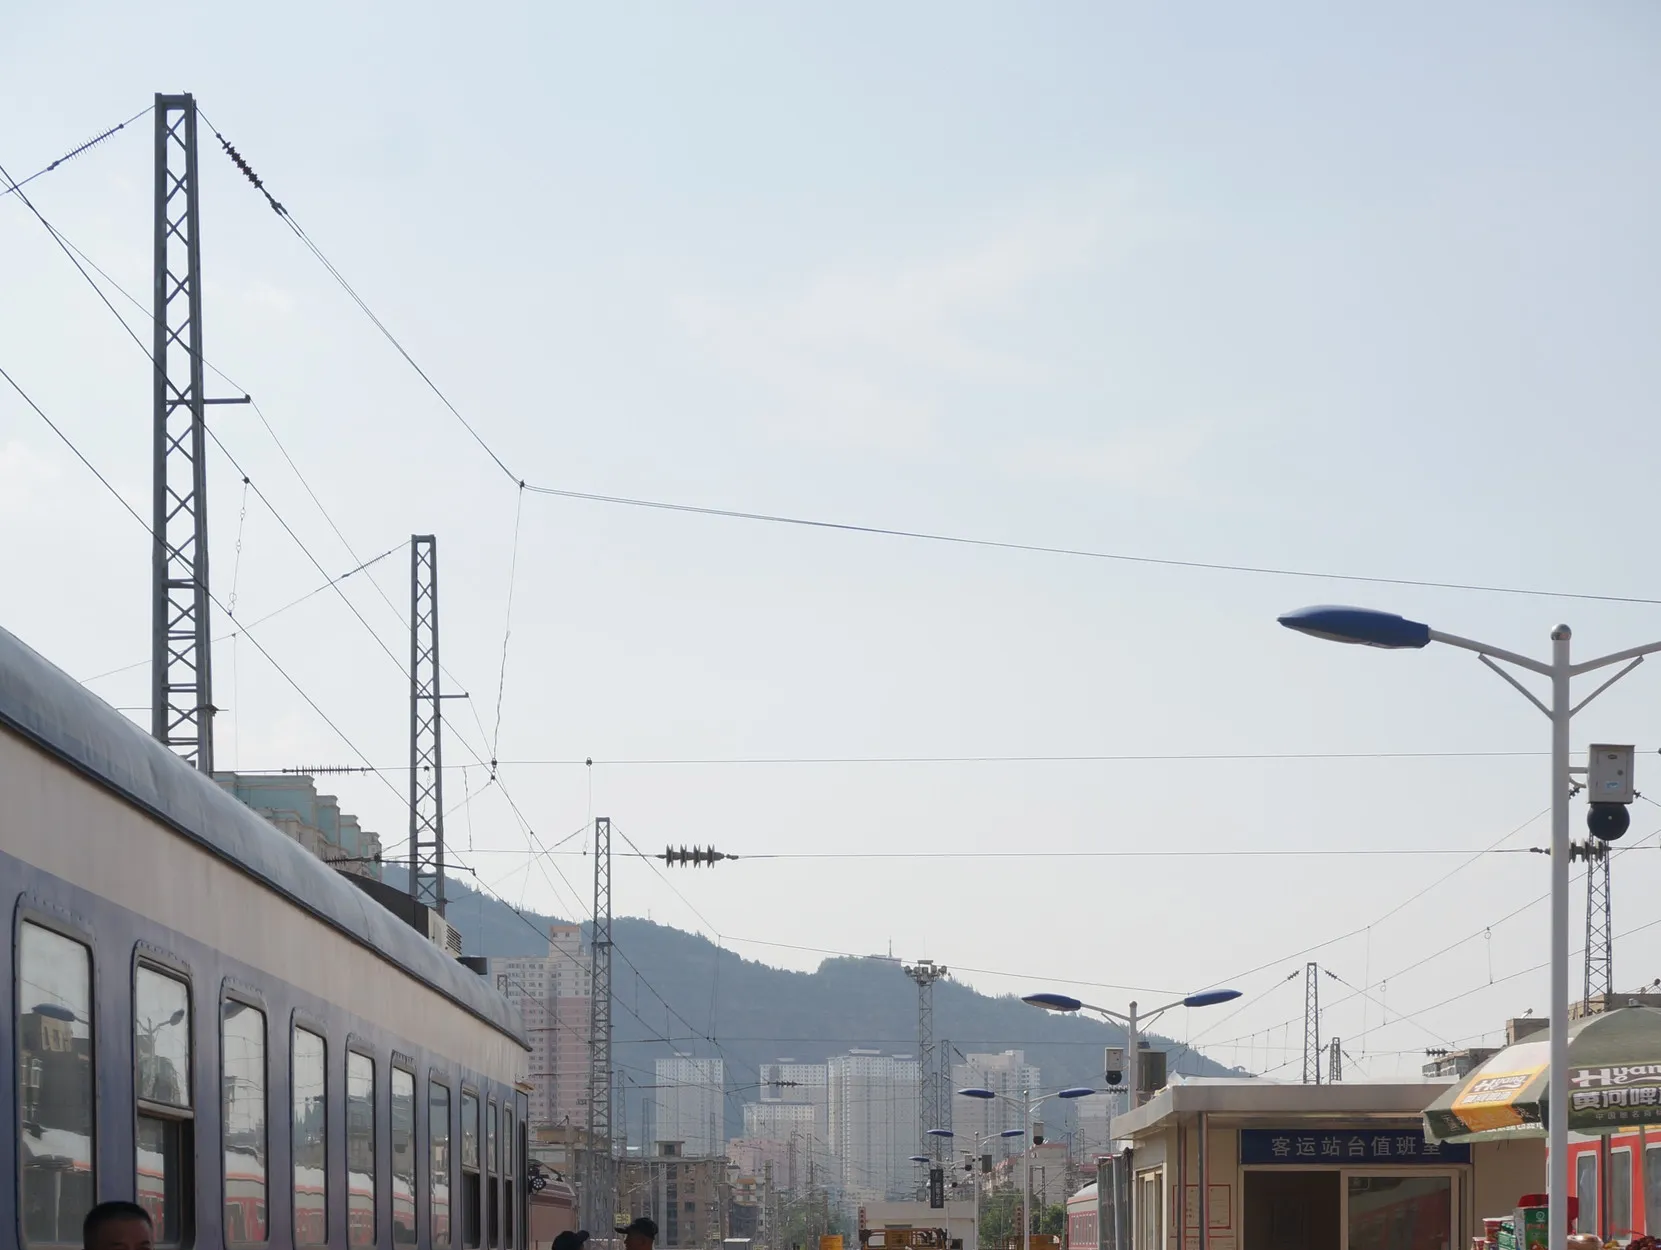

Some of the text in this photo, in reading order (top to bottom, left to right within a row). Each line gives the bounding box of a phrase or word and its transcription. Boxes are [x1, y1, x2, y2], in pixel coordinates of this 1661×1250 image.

[1572, 1087, 1661, 1111] 黄河啤
[1271, 1136, 1442, 1157] 客运站台值班室
